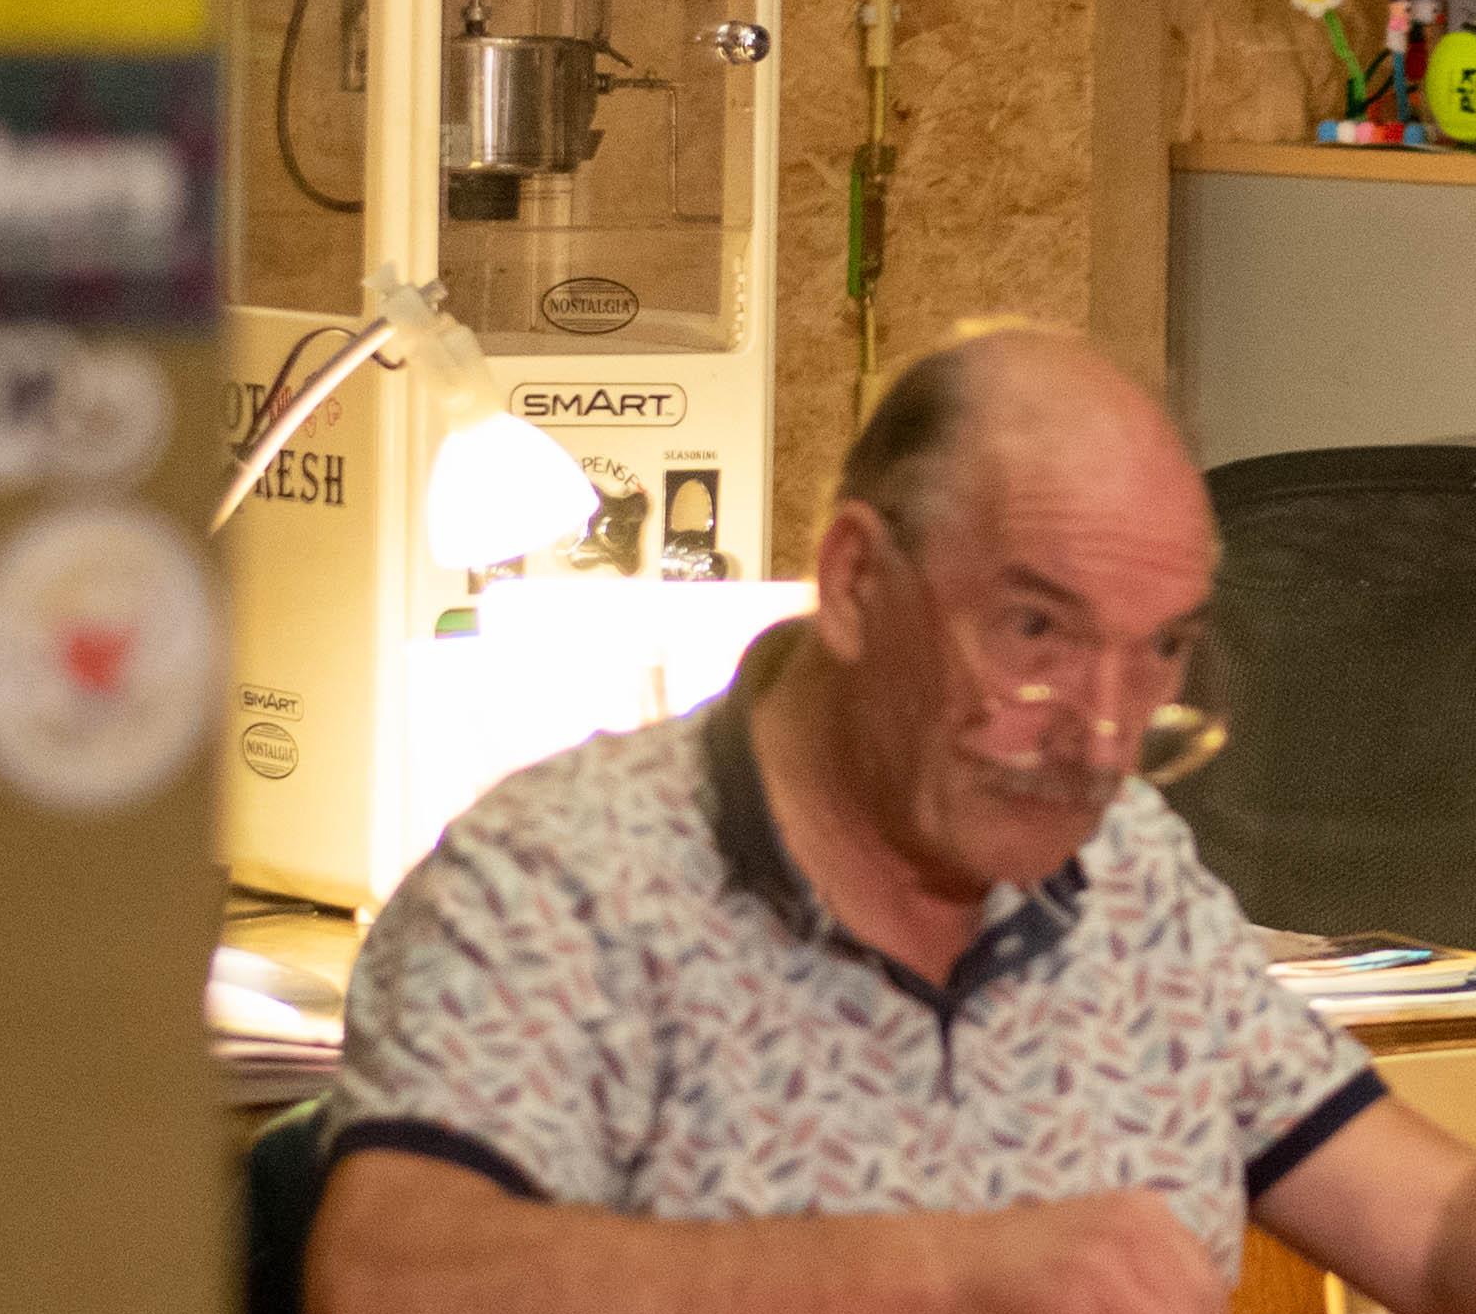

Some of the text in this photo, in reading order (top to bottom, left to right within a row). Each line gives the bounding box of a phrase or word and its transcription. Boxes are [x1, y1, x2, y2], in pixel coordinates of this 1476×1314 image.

[548, 296, 632, 315] NOSTALGIA
[223, 381, 268, 432] OT
[523, 388, 672, 417] SMART
[664, 450, 718, 461] SEASONING
[254, 448, 346, 507] RESH
[243, 690, 299, 715] SMART
[246, 738, 295, 764] NOSTALGIA
